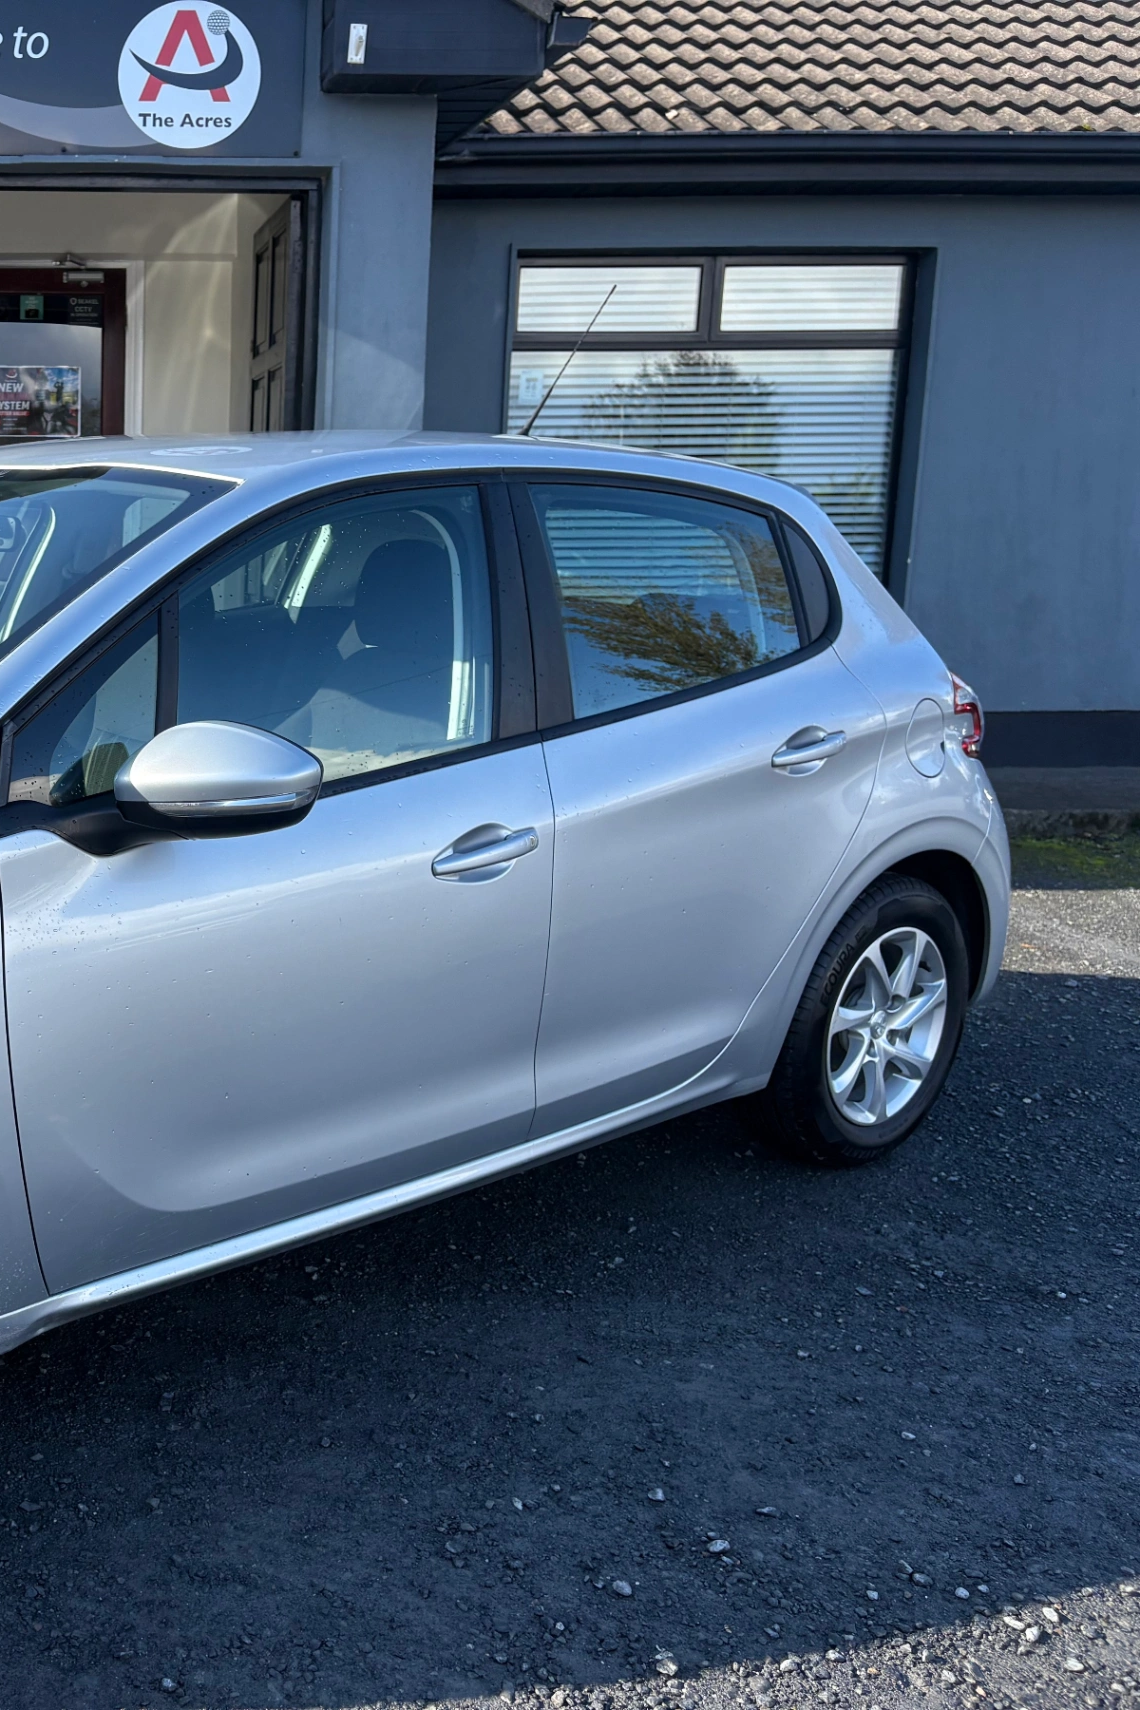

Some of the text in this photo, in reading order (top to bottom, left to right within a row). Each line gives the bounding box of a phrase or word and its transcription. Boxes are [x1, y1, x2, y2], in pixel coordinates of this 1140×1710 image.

[13, 26, 50, 59] to
[138, 112, 232, 128] The Acres
[821, 943, 855, 1002] ECOURA
